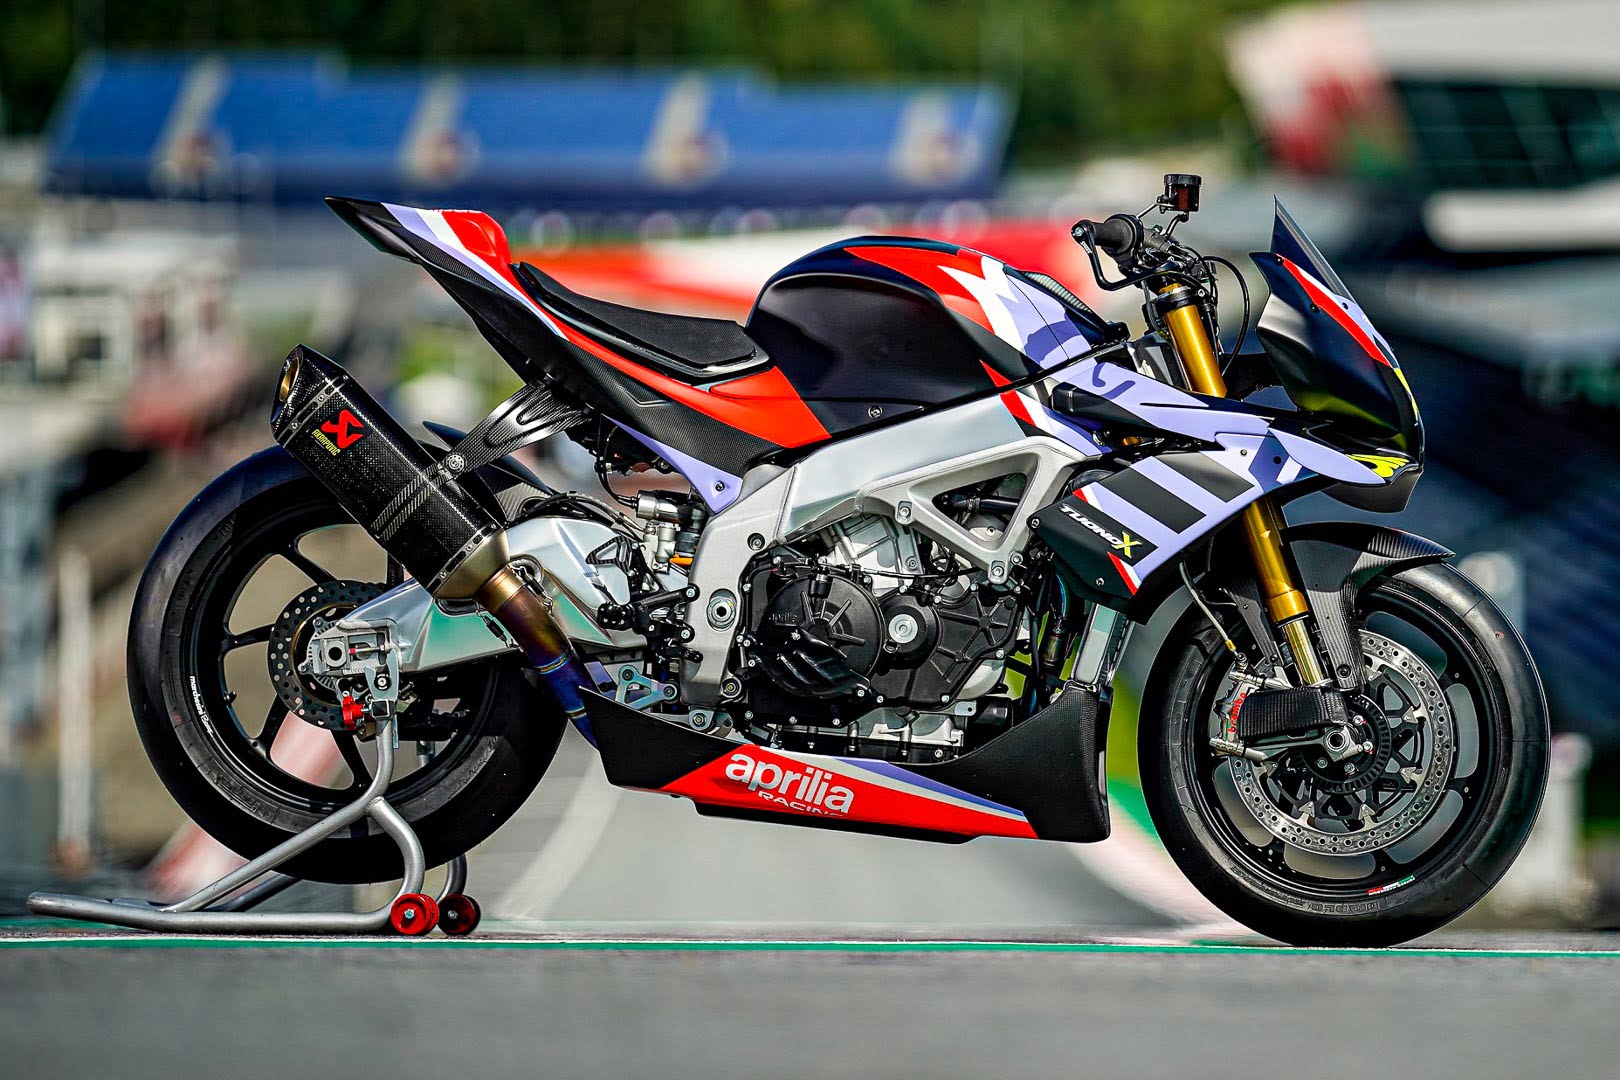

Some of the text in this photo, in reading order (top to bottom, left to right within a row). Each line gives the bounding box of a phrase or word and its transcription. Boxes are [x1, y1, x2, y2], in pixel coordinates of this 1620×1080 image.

[1227, 692, 1247, 733] brembo
[725, 753, 855, 814] aprilia
[757, 790, 846, 816] RACIN
